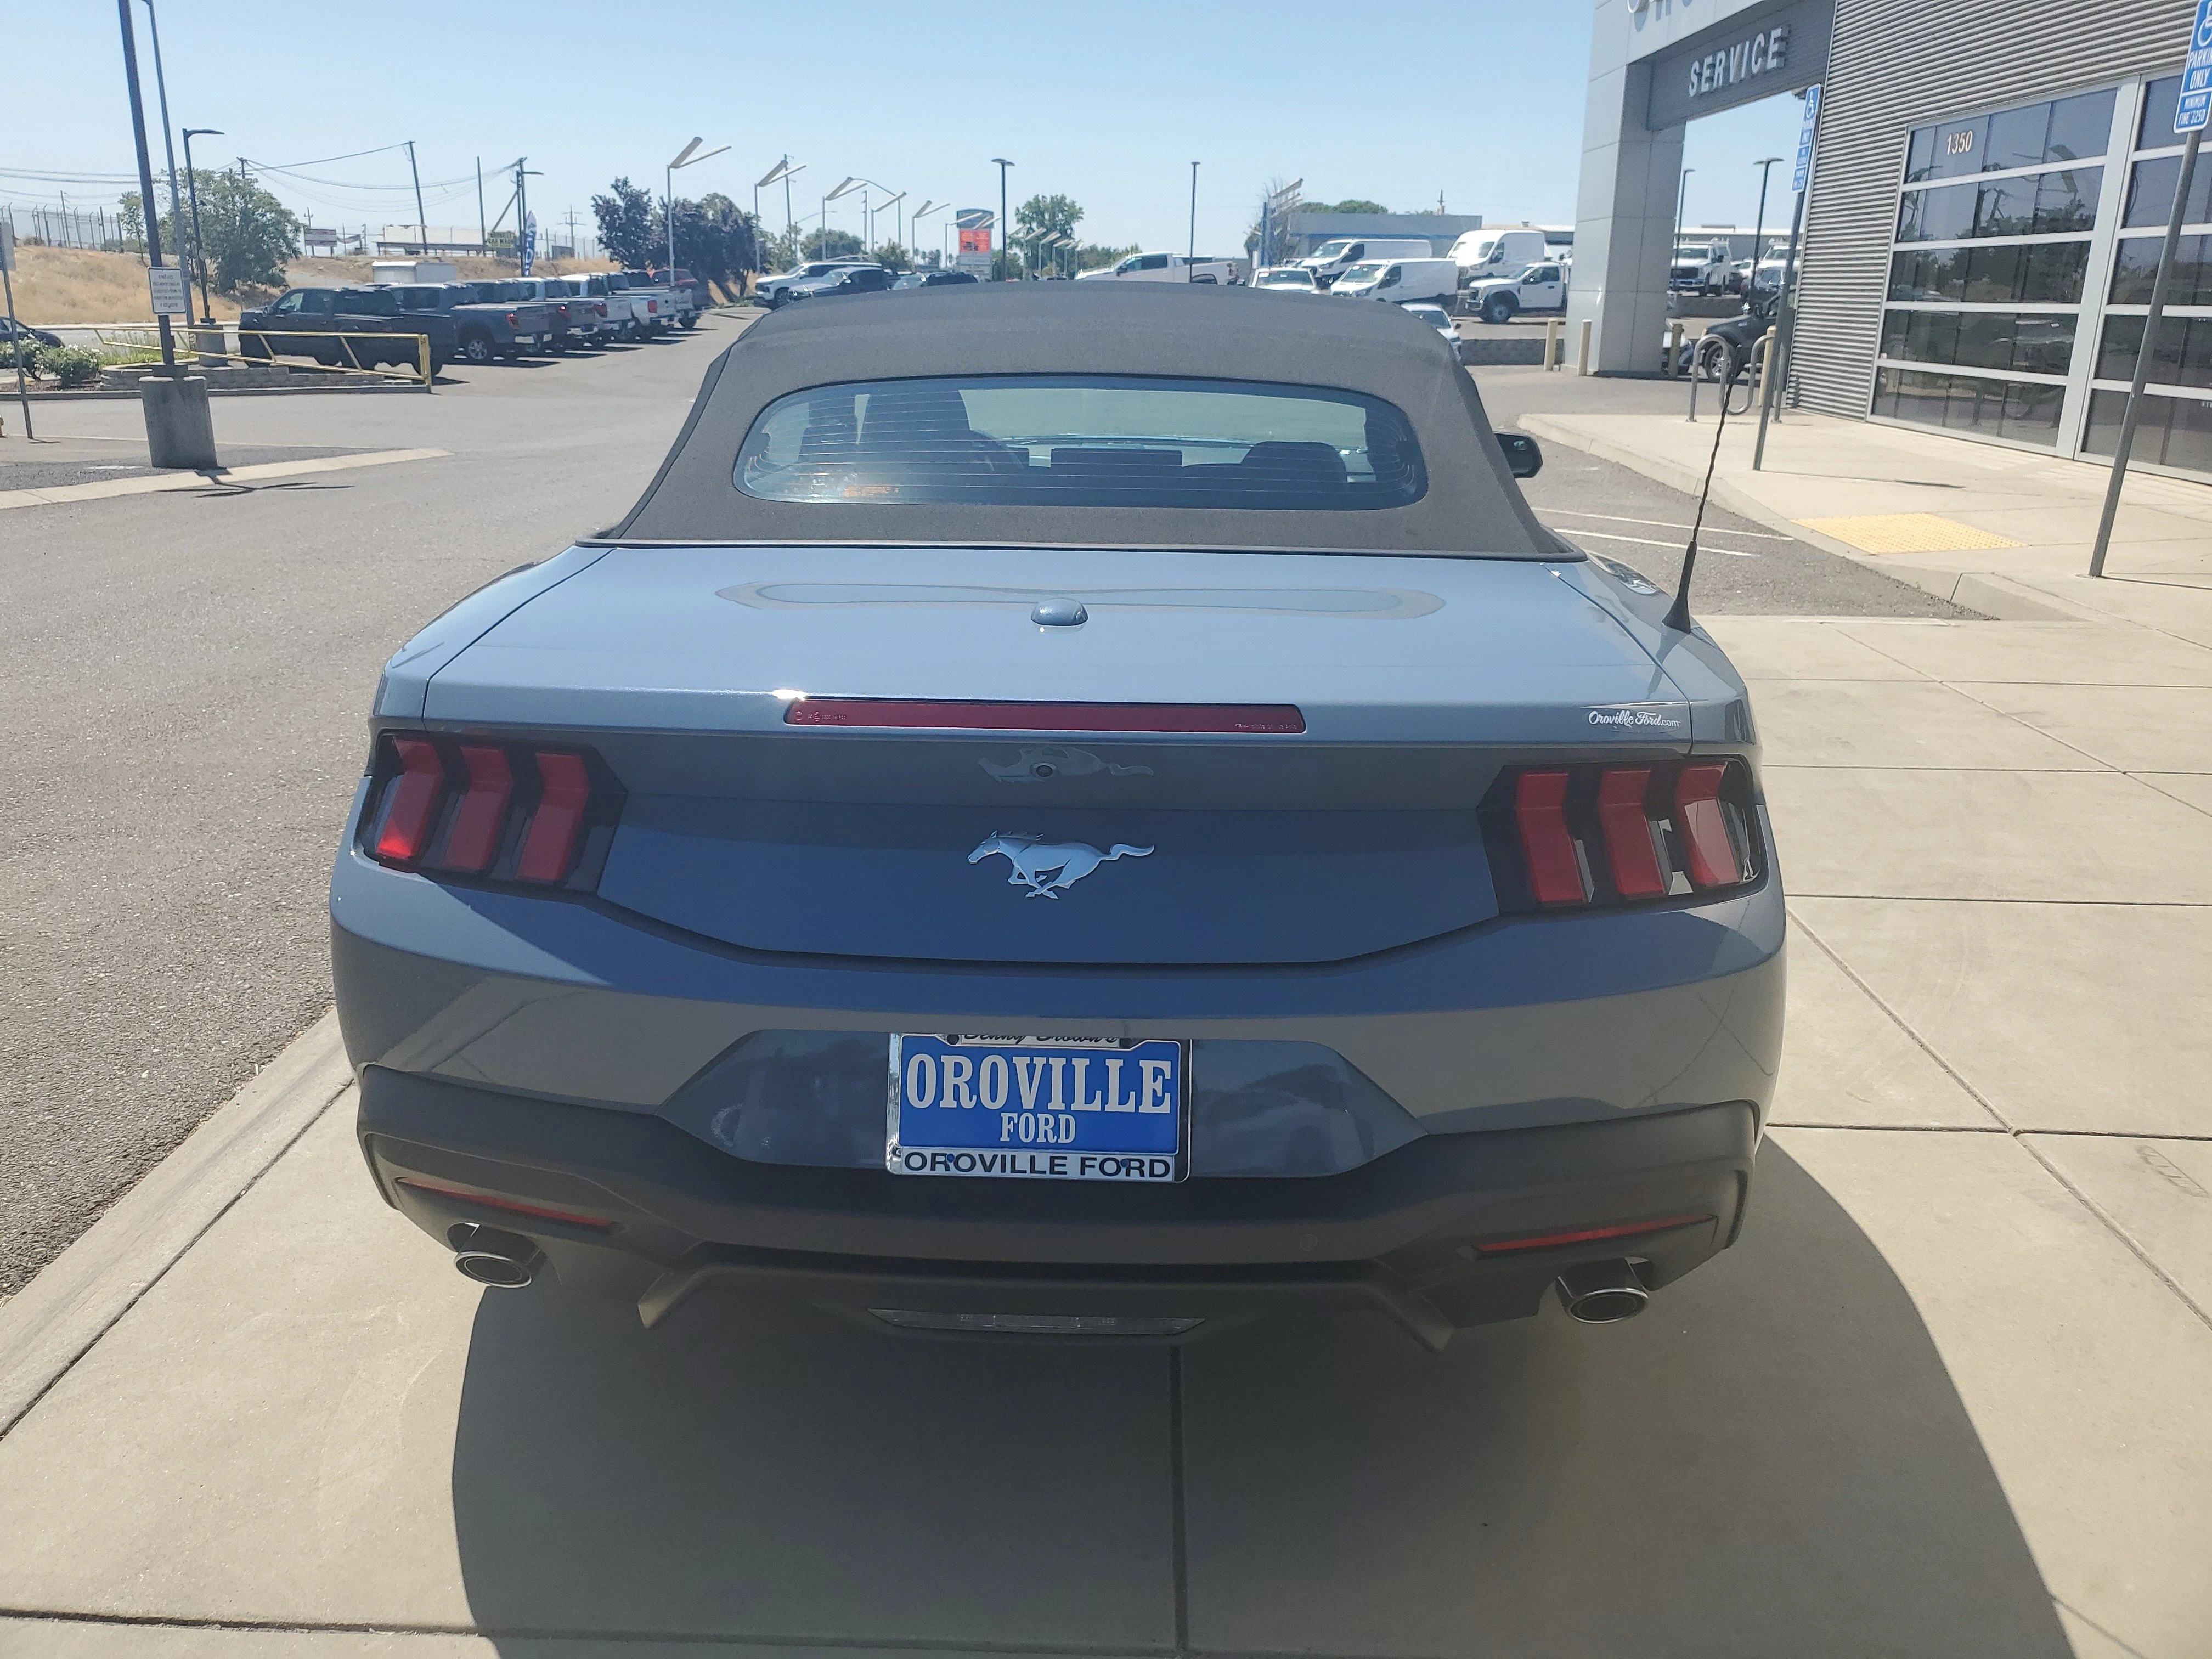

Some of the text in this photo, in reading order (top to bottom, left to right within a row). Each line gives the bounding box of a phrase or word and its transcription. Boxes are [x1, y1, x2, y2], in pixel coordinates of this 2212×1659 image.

[1689, 27, 1782, 97] SERVICE
[2190, 68, 2210, 90] ONLY
[2179, 111, 2190, 126] FINE
[1947, 130, 1973, 155] 1350
[906, 1053, 1171, 1114] OROVILLE
[1000, 1112, 1076, 1144] FORD
[904, 1152, 1171, 1178] OROVILLE FORD
